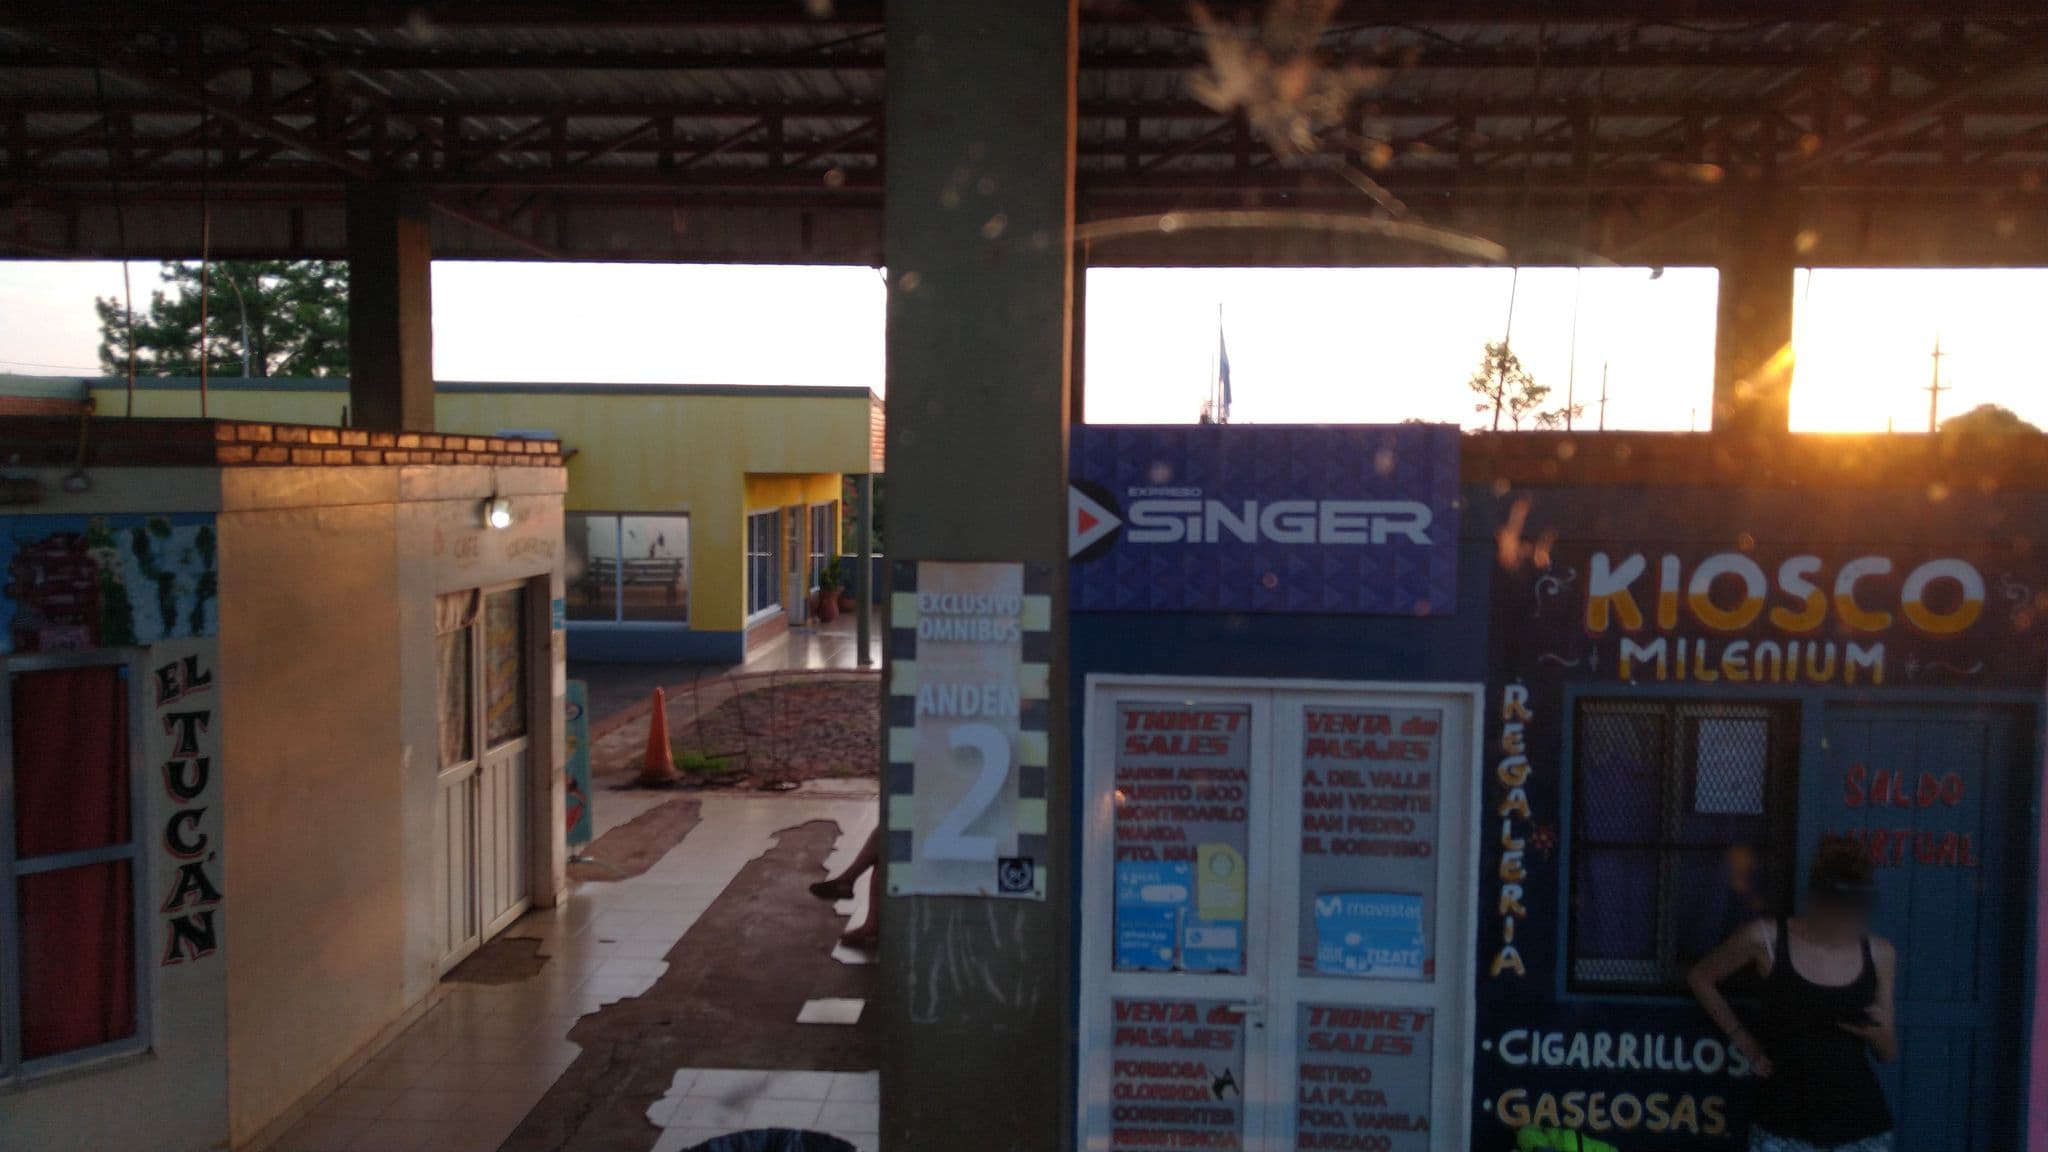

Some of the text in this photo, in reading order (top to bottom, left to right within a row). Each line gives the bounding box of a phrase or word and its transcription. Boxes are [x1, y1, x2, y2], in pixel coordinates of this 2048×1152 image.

[918, 592, 1021, 614] EXCLUSIVO
[1584, 552, 1987, 634] KIOSCO
[919, 617, 1020, 641] OMNIBUS
[1618, 638, 1886, 685] MILENIUM
[154, 654, 211, 708] EL
[916, 681, 1019, 717] ANDEN
[1121, 710, 1248, 731] TICKET
[1306, 709, 1391, 735] VENTA
[1123, 735, 1231, 756] SALES
[1306, 737, 1432, 762] PASAJES
[922, 721, 1011, 861] 2
[1327, 769, 1366, 788] DEL
[1368, 770, 1431, 789] VALLE
[1844, 761, 1965, 808] SALDO
[1303, 791, 1343, 809] SAN
[1303, 814, 1416, 836] SAN PEDRO
[1490, 682, 1533, 977] REGALERIA
[1114, 1000, 1198, 1023] VENTA
[1305, 1007, 1430, 1031] TICKET
[1115, 1026, 1236, 1049] PASAJES
[1305, 1032, 1414, 1056] SALES
[1498, 1029, 1754, 1078] CIGARRILLOS
[1113, 1060, 1208, 1079] FORMOSA
[1298, 1064, 1371, 1083] RETIRO
[1298, 1086, 1387, 1107] LA PLATA
[1351, 1112, 1428, 1131] VARELA
[1496, 1088, 1728, 1136] GASEOSAS
